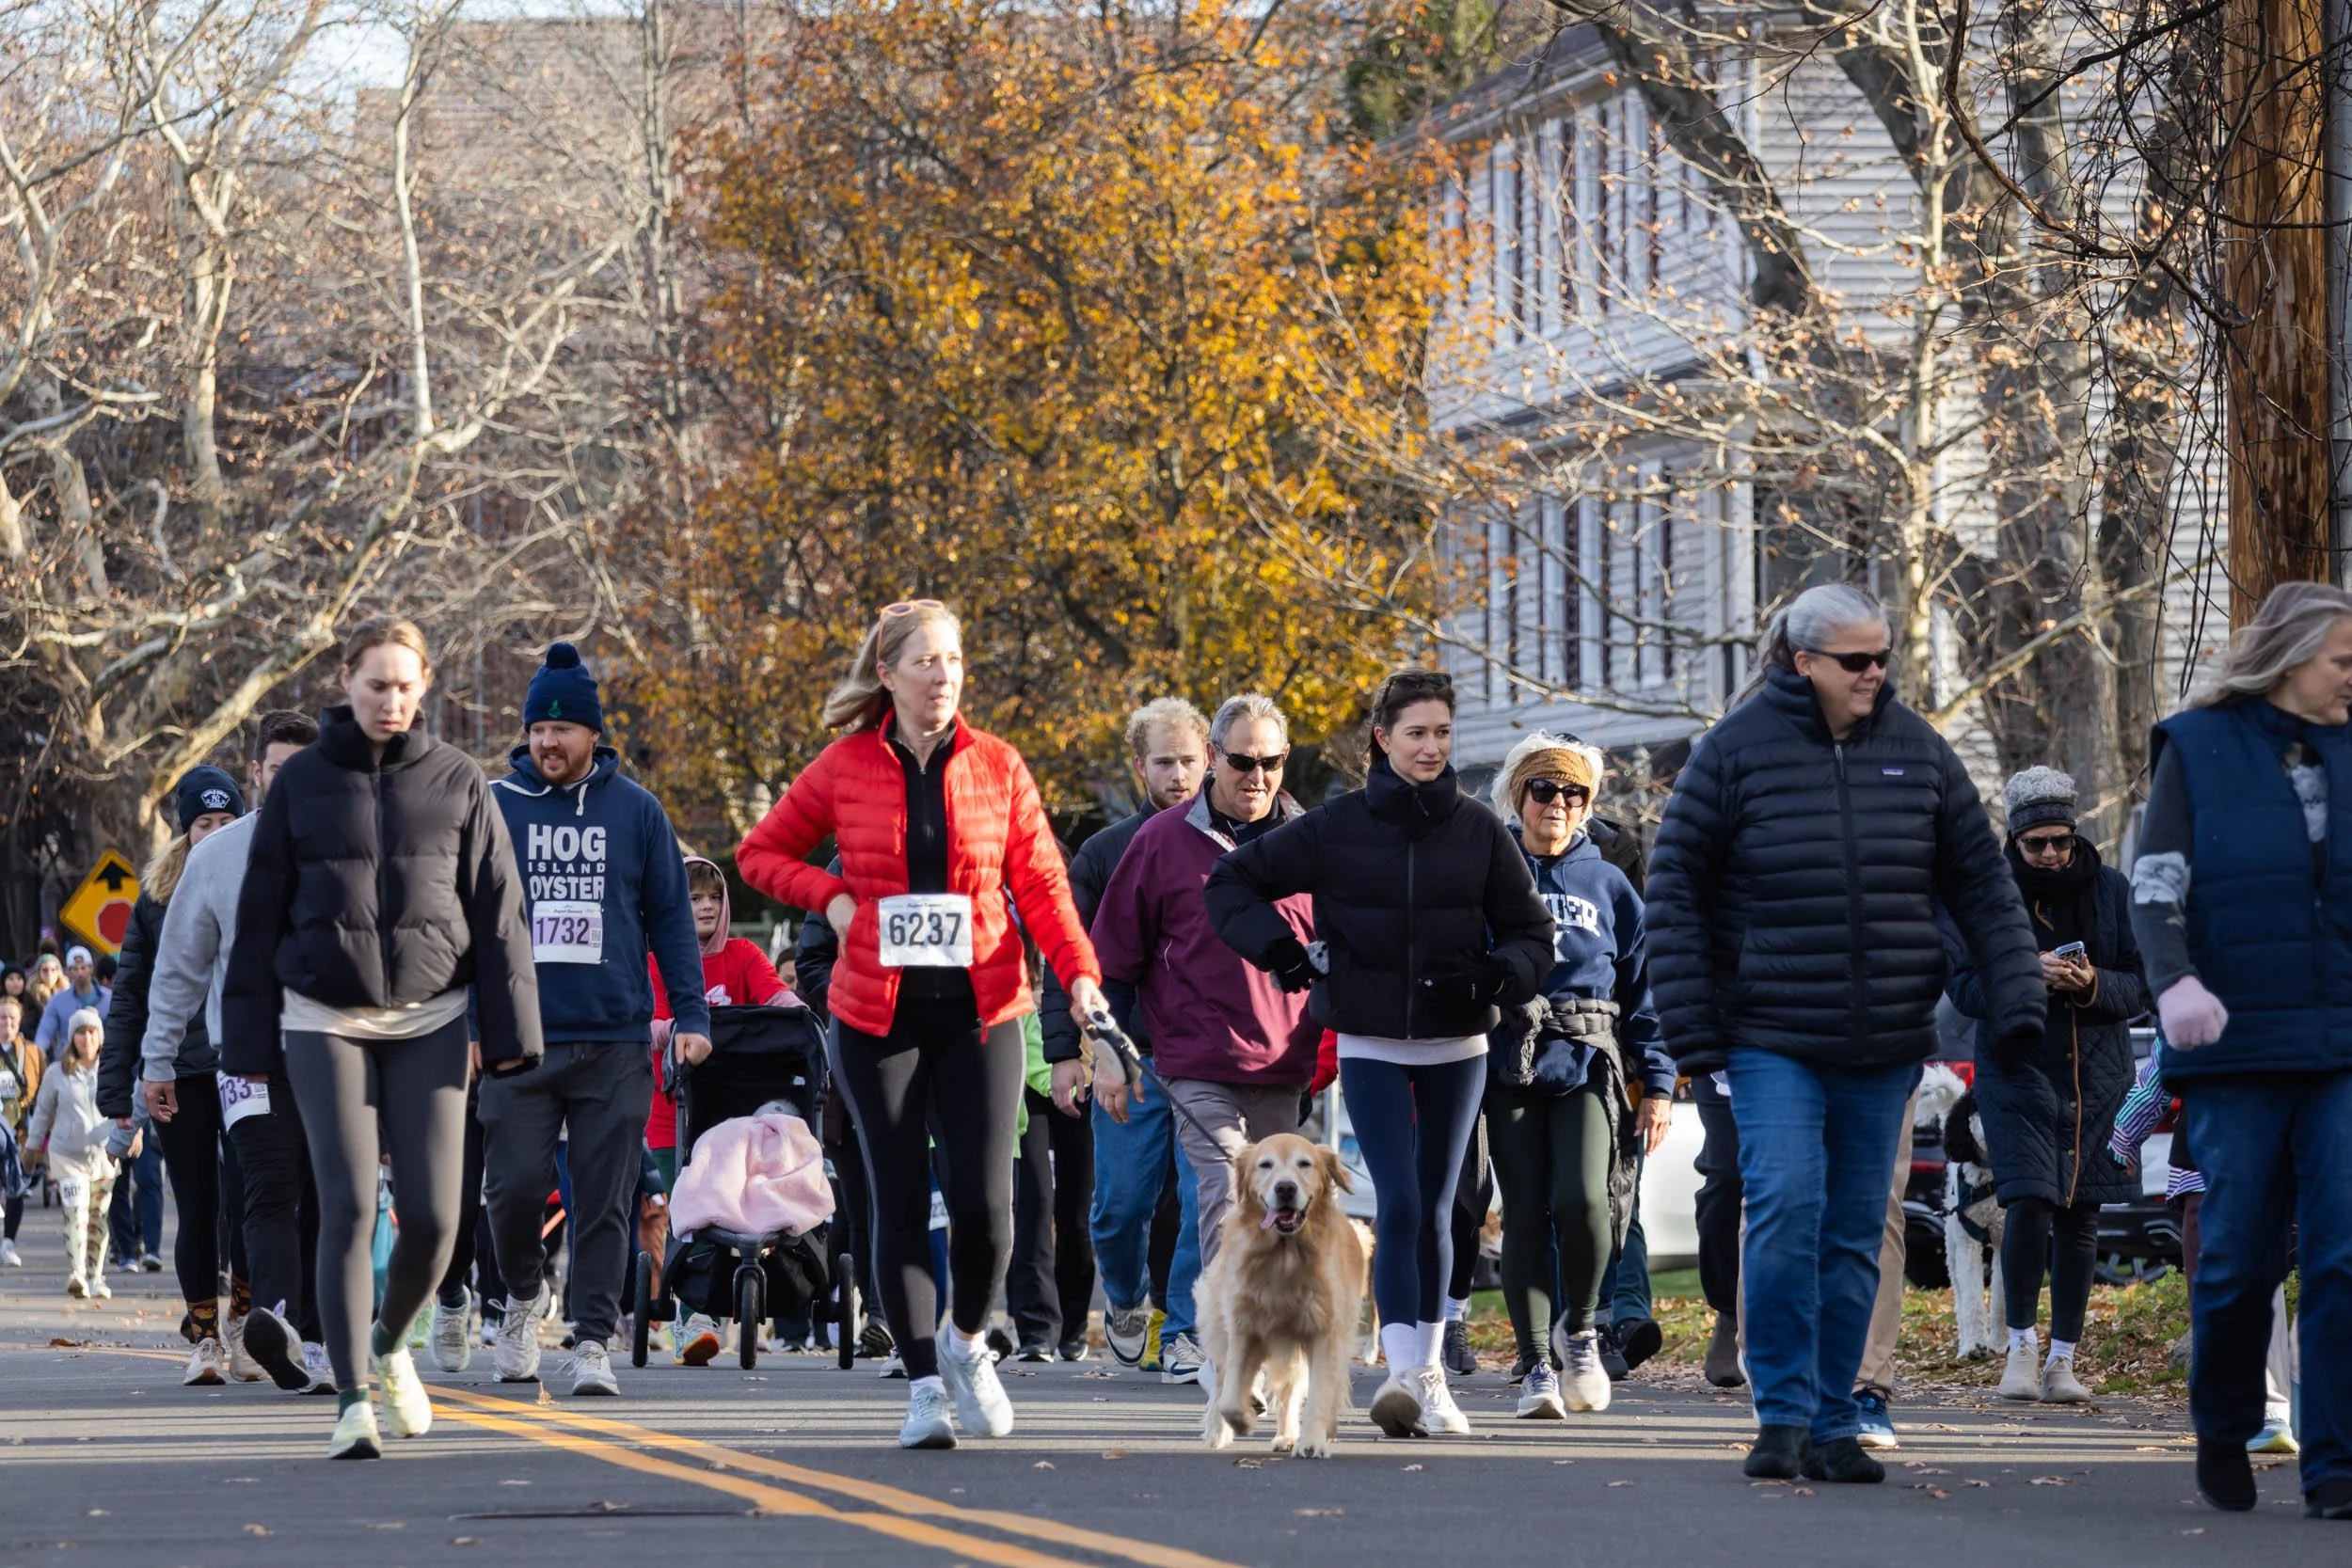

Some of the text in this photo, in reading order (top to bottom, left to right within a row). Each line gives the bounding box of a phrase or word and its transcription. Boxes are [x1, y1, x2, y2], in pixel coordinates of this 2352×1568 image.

[528, 823, 607, 863] HOG
[528, 862, 607, 875] ISLAND
[529, 875, 605, 900] OYSTER
[535, 916, 590, 945] 1732
[888, 911, 962, 947] 6237
